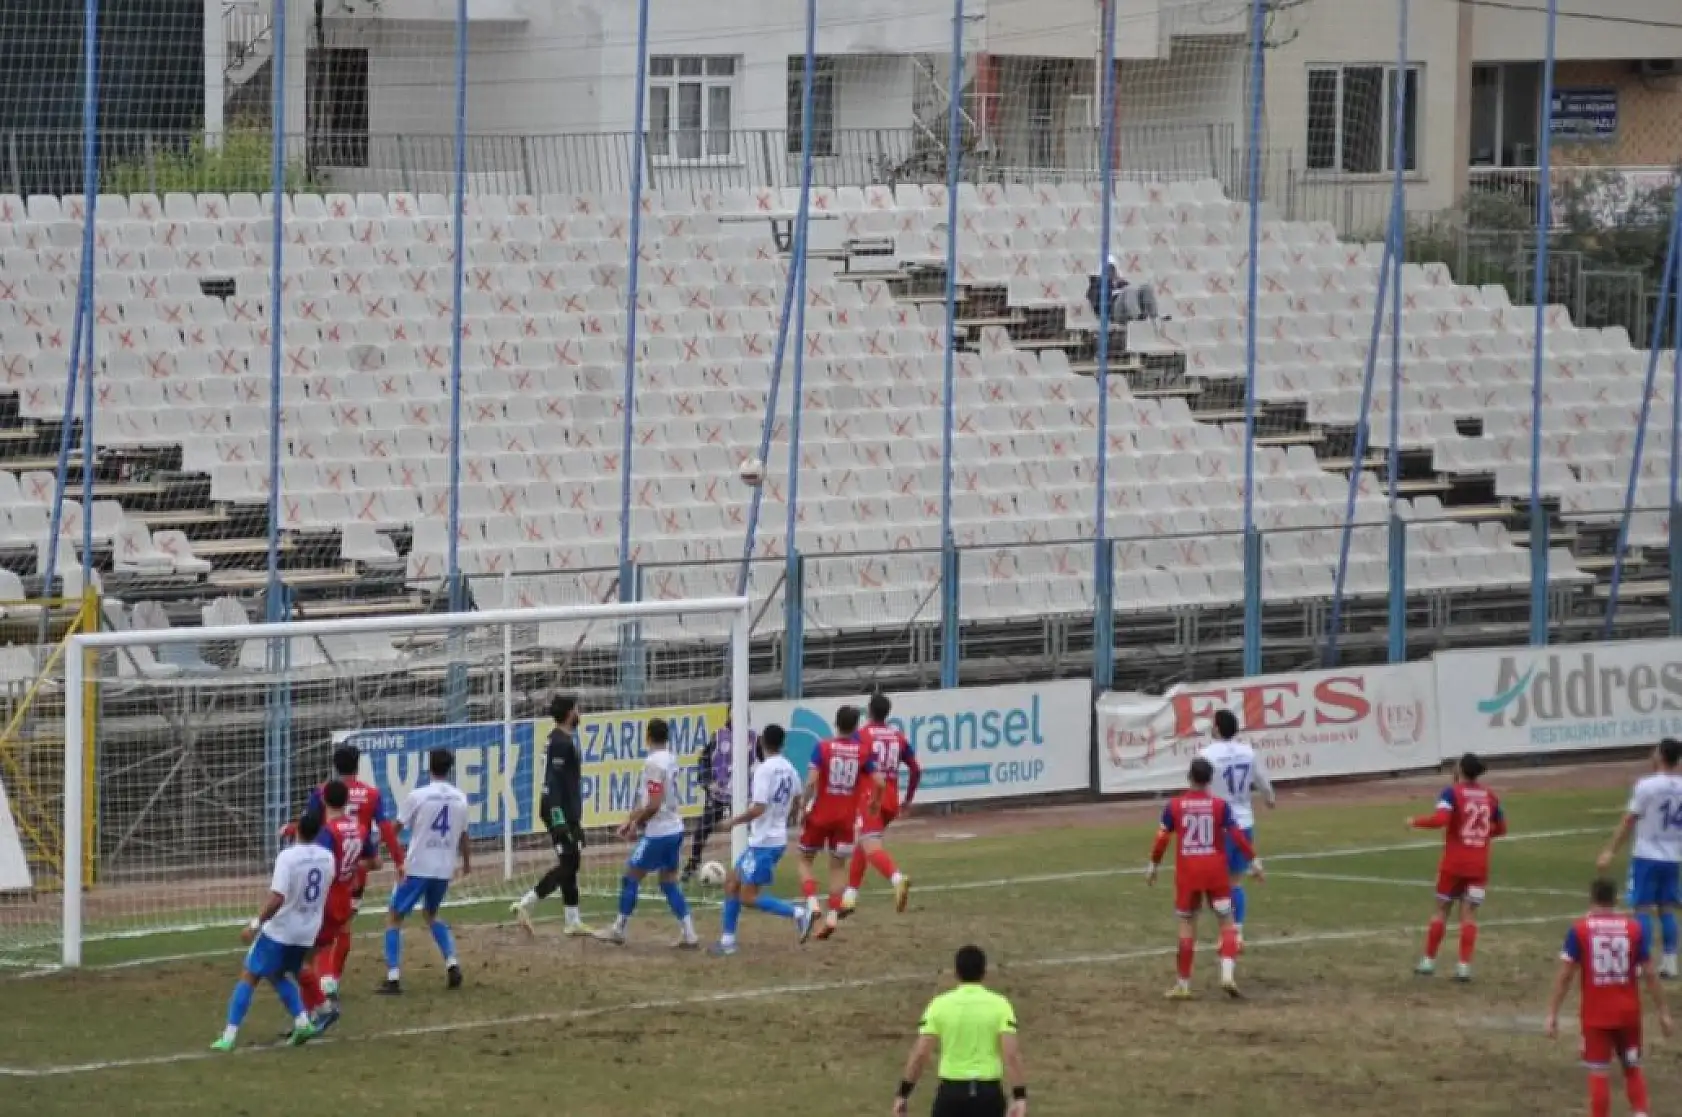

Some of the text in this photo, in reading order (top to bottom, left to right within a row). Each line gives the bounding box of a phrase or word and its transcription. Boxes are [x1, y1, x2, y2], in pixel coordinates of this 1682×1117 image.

[1223, 764, 1251, 796] 17
[431, 804, 450, 838] 4
[1182, 814, 1214, 846] 20
[1459, 803, 1492, 839] 23
[304, 867, 322, 902] 8
